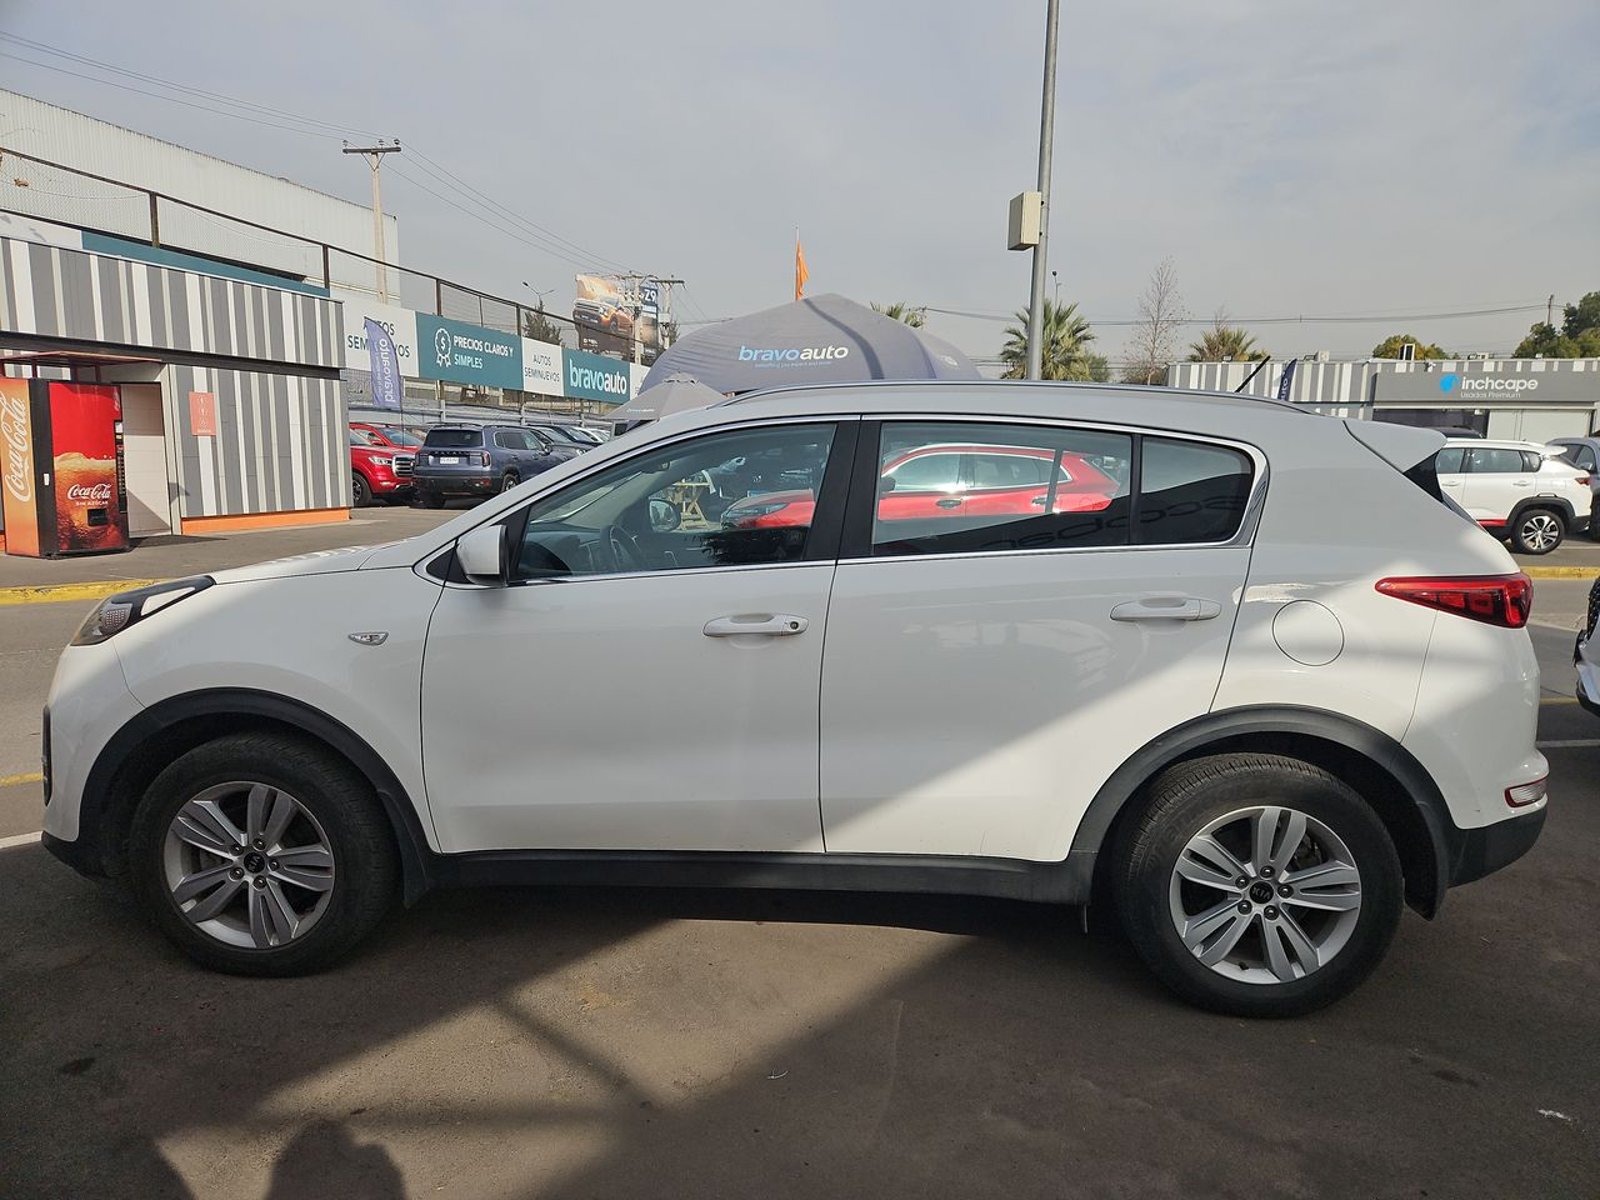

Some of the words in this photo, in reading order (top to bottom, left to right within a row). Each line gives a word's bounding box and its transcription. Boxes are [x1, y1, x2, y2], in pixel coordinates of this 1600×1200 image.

[454, 335, 483, 352] PRECIOS
[484, 342, 508, 357] CLAROS
[509, 346, 514, 357] Y
[738, 345, 849, 361] bravoauto
[454, 354, 483, 369] SIMPLES
[533, 354, 552, 366] AUTOS
[569, 358, 628, 395] bravoauto
[1461, 376, 1538, 392] inchcape
[67, 483, 112, 500] Coca-Cola
